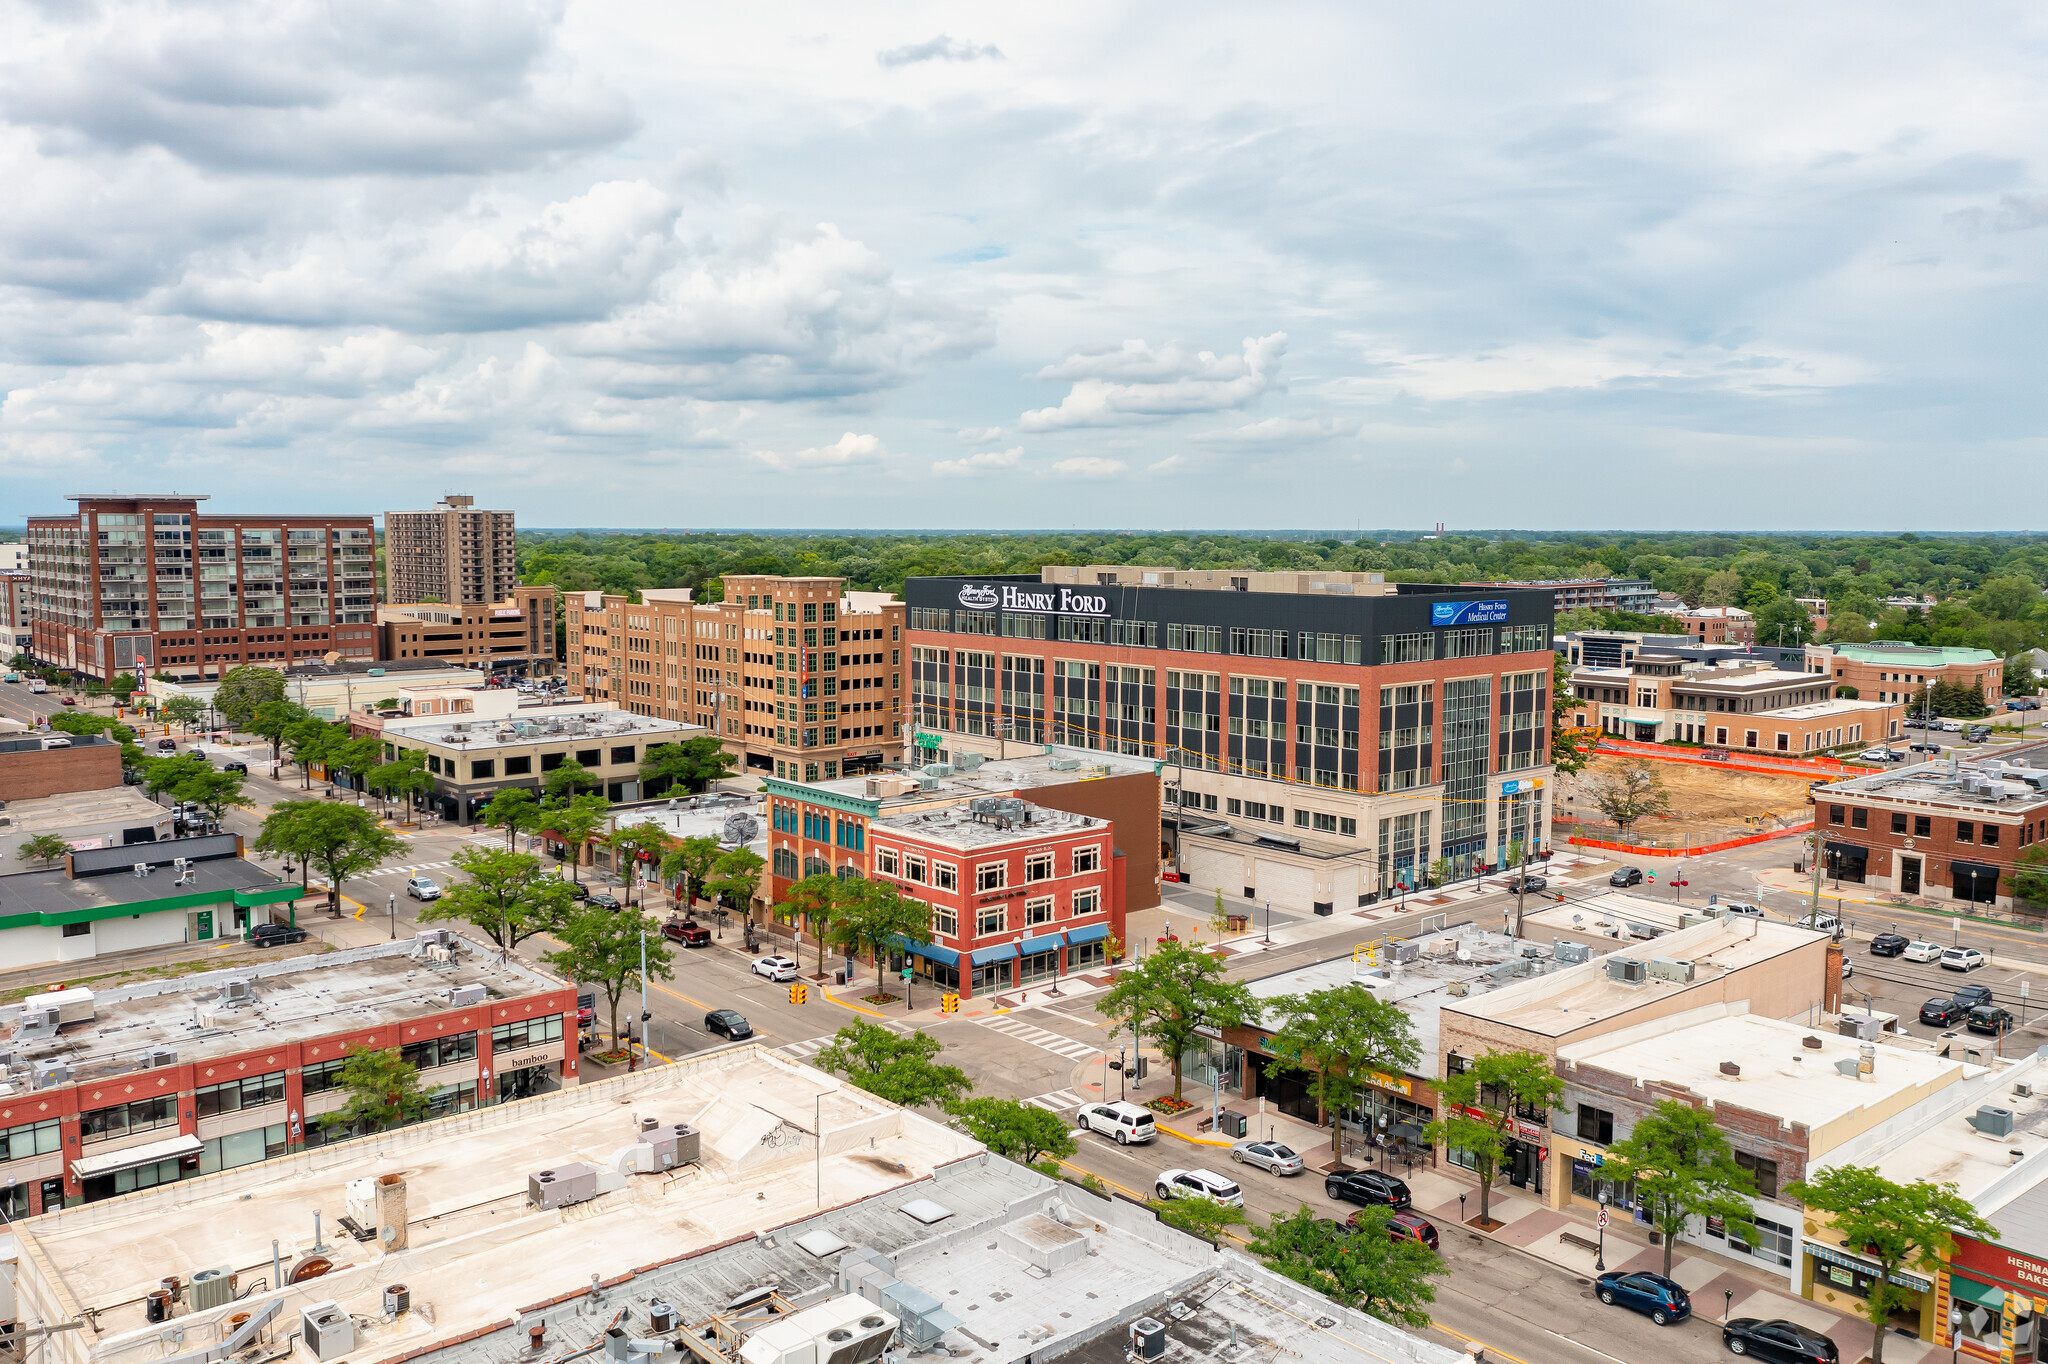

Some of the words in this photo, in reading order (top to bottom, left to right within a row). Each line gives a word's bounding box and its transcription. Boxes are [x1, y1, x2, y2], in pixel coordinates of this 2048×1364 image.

[1001, 585, 1056, 611] HENRY
[1060, 588, 1107, 614] FORD
[1467, 612, 1489, 622] Medical
[1489, 610, 1507, 621] Center
[137, 662, 145, 691] MAIN
[917, 739, 939, 750] CLINIC
[512, 1053, 549, 1068] bamboo
[1831, 1266, 1852, 1278] OPEN
